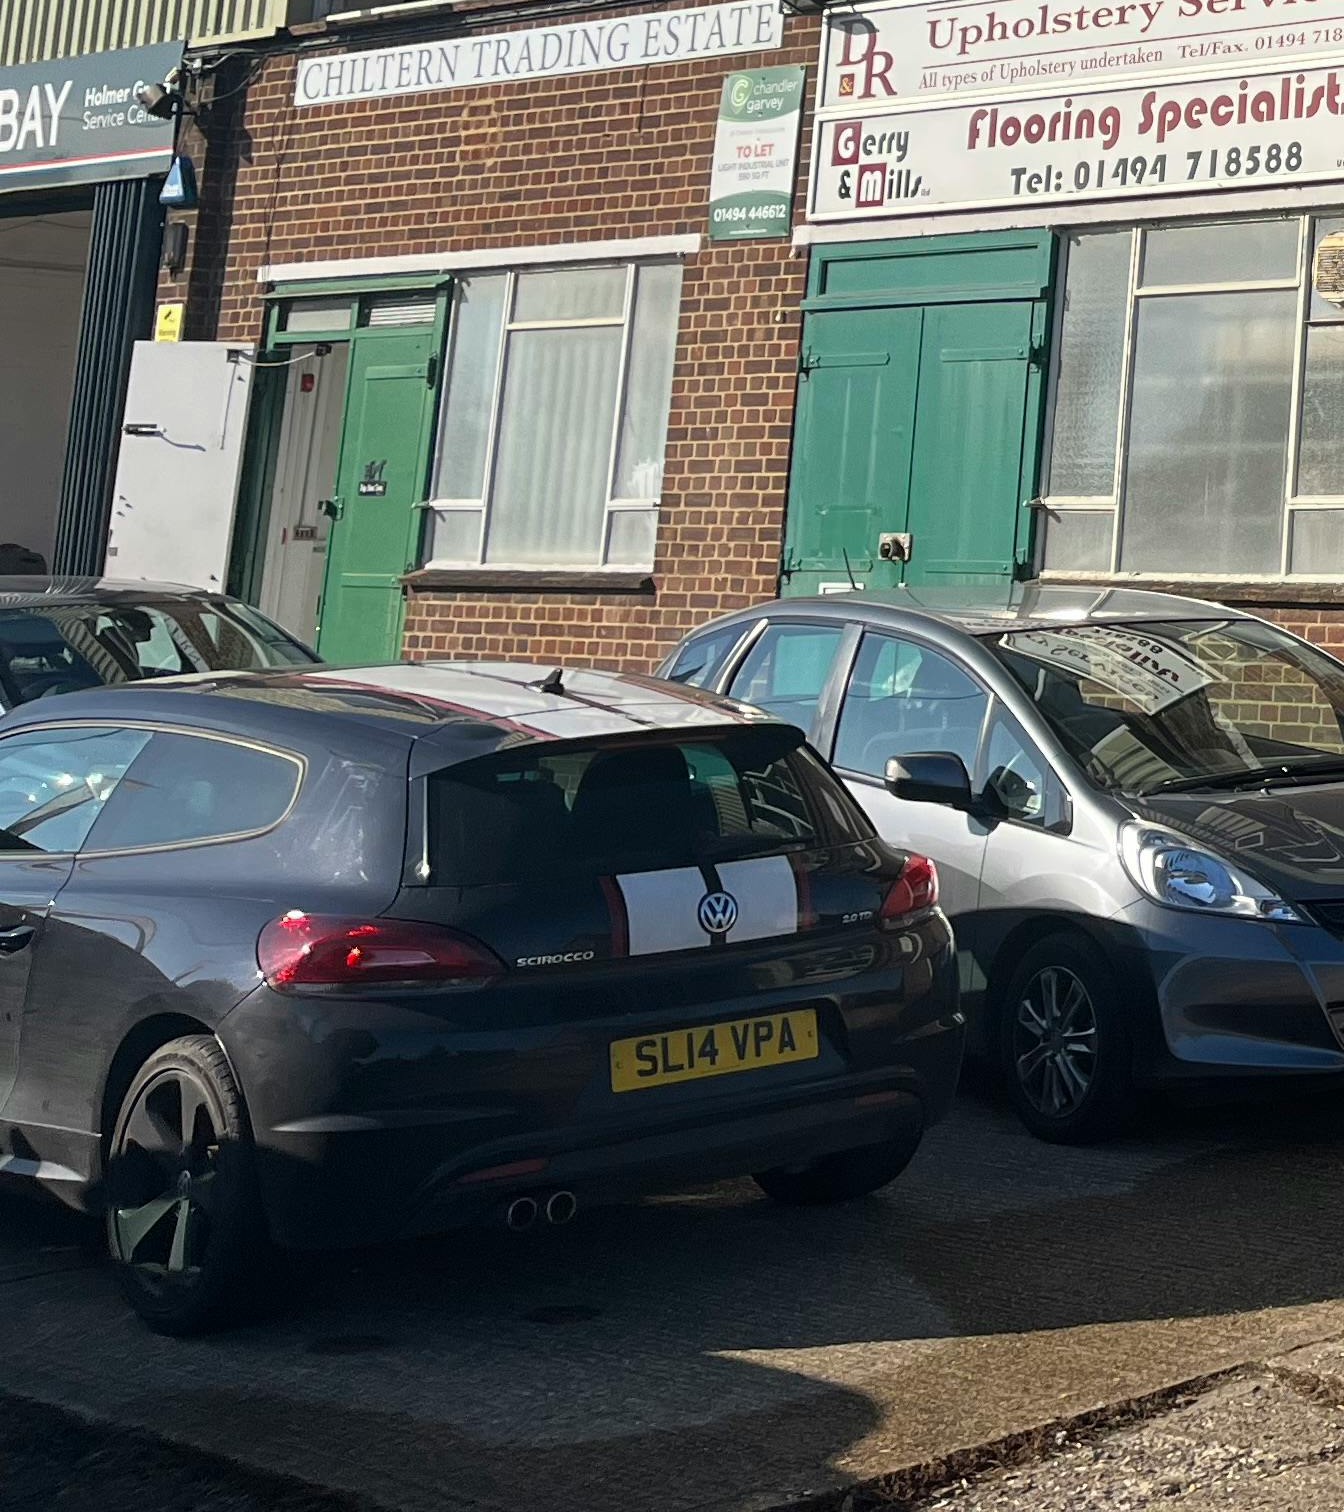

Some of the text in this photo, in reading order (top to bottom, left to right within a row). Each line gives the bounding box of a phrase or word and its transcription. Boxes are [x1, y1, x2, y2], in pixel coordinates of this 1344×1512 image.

[927, 0, 1165, 55] Upholstery
[303, 3, 775, 100] CHILTERN TRADING ESTATE
[919, 71, 938, 89] All
[942, 69, 977, 91] types
[981, 65, 997, 81] of
[1000, 59, 1077, 84] Upholstery
[1081, 48, 1163, 71] undertaken
[1255, 31, 1306, 51] 01494
[84, 85, 131, 107] Holmer
[753, 79, 798, 95] chandler
[82, 109, 125, 130] Service
[746, 97, 784, 113] garvey
[967, 98, 1121, 150] Flooring
[736, 144, 774, 157] TO LET
[836, 127, 910, 162] Gerry
[1010, 141, 1303, 195] Tel: 01494 718588
[838, 169, 852, 199] &
[858, 169, 922, 203] Mills
[714, 204, 786, 223] 01494 446612
[516, 950, 594, 967] SCIROCCO
[635, 1016, 797, 1078] SL14 VPA
